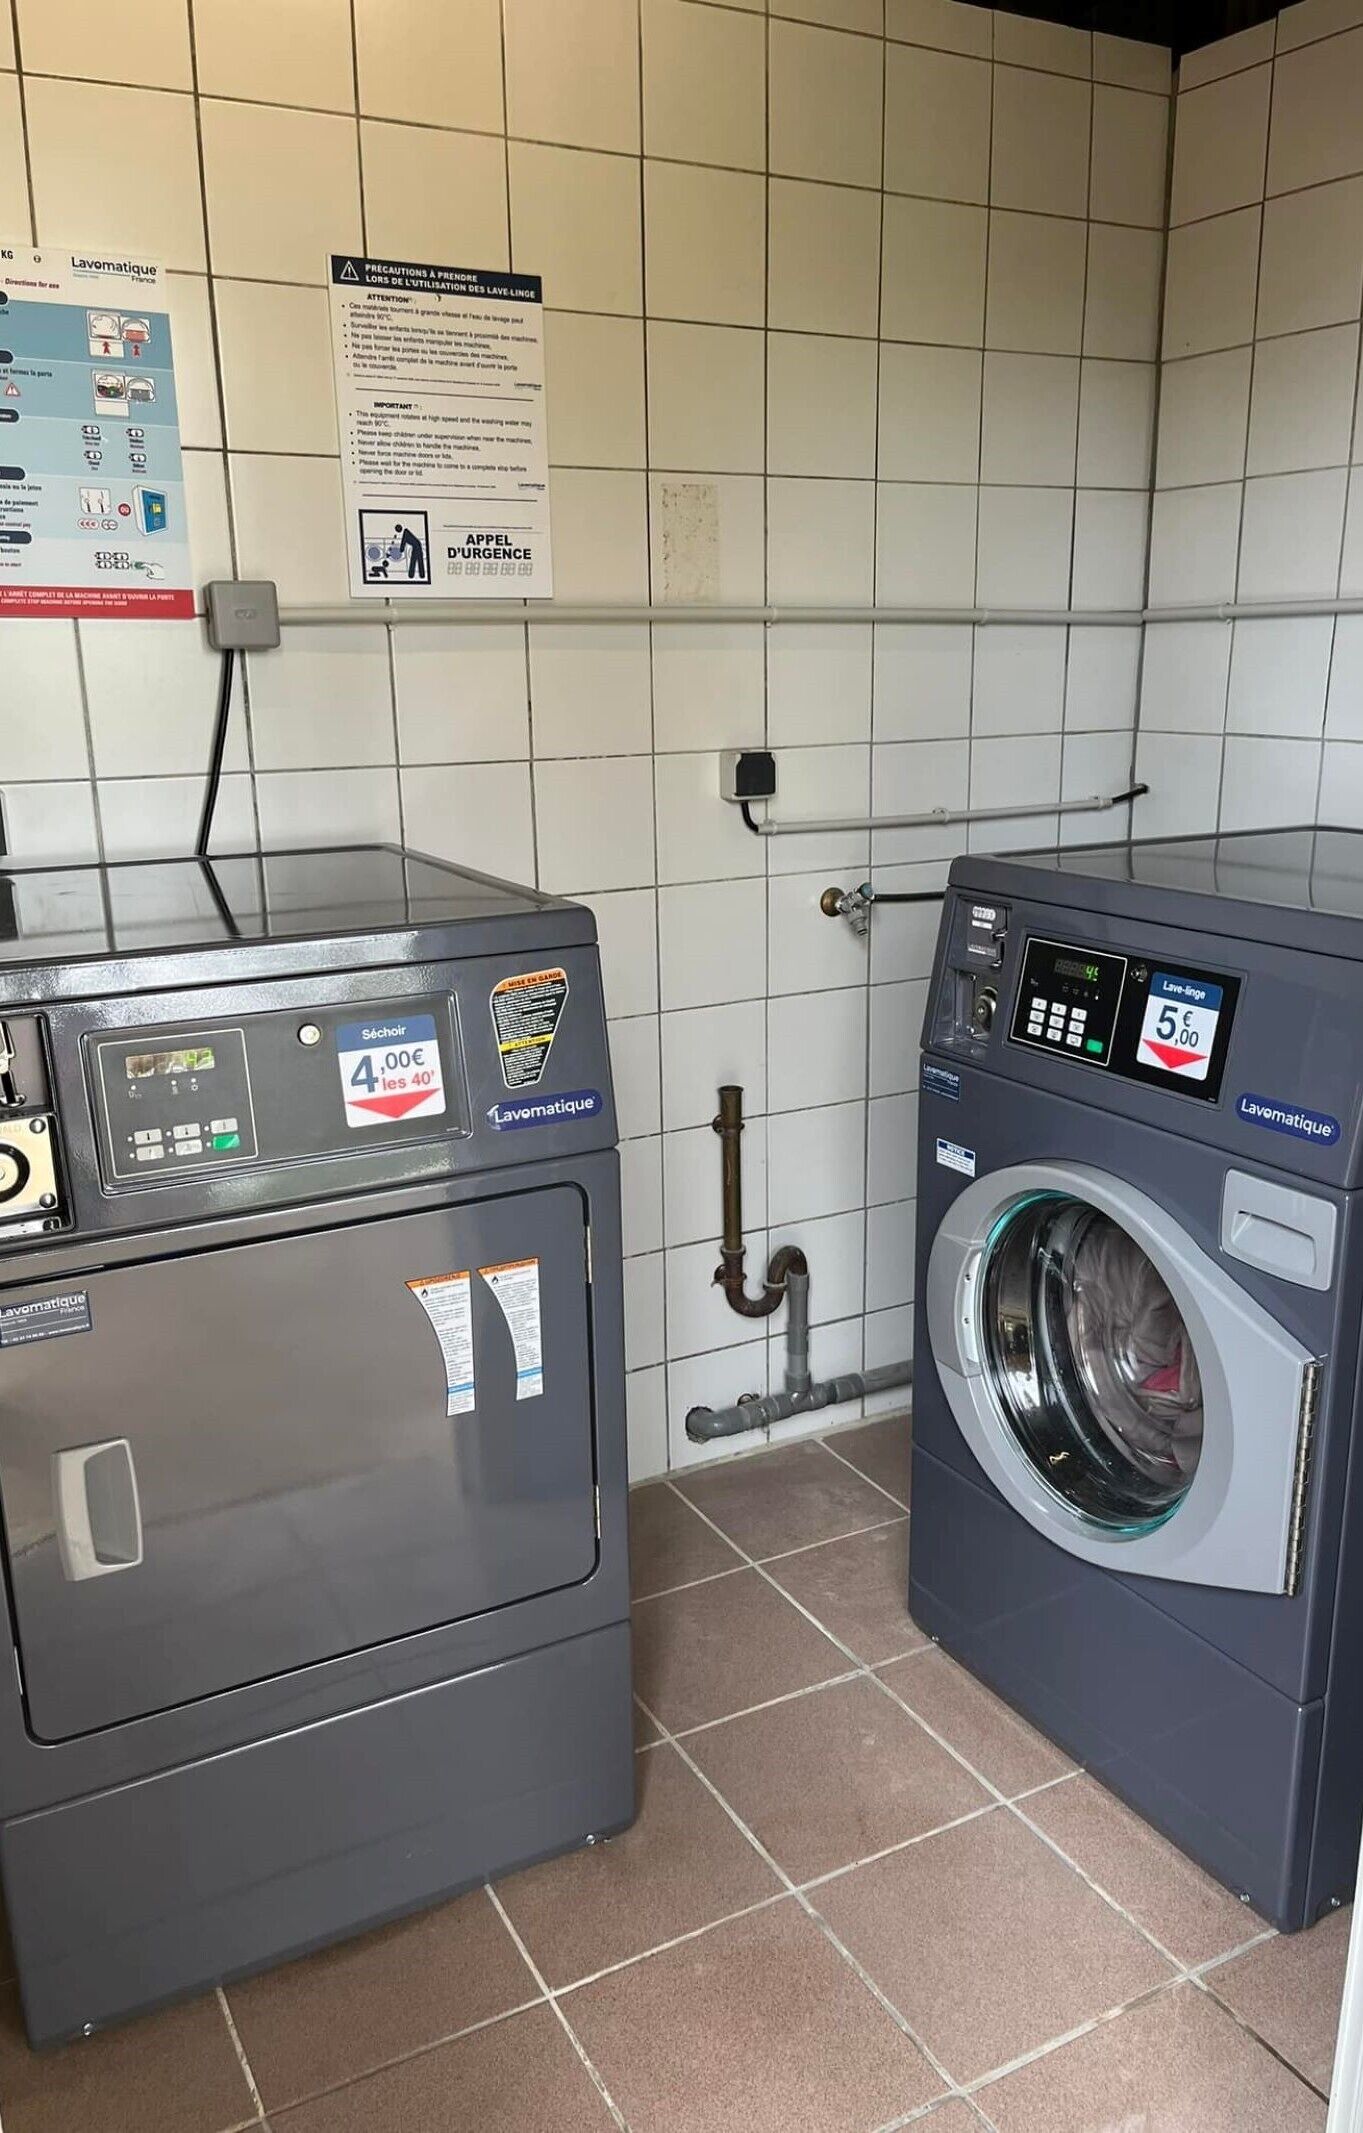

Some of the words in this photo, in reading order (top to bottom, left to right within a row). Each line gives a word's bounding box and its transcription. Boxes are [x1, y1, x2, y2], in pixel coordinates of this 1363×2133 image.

[1, 250, 14, 259] KG
[72, 256, 156, 276] Lavomatique
[365, 263, 427, 277] PRÉCAUTIONS
[430, 269, 435, 278] À
[438, 272, 477, 282] PRENDRE
[132, 276, 156, 284] France
[366, 275, 389, 283] LORS
[392, 277, 403, 285] DE
[406, 278, 466, 291] L'UTILISATION
[468, 285, 485, 293] DES
[487, 287, 535, 298] LAVE-LINGE
[466, 534, 512, 546] APPEL
[448, 547, 531, 559] D'URGENCE
[508, 979, 526, 987] MISE
[538, 972, 562, 980] GARDE
[1163, 981, 1206, 1000] Lave-linge
[362, 1025, 407, 1039] Séchoir
[382, 1077, 406, 1091] les
[411, 1070, 434, 1086] 40'
[494, 1098, 594, 1123] Lavomatique
[1241, 1098, 1332, 1136] Lavomatique
[0, 1295, 85, 1318] Lavomatique
